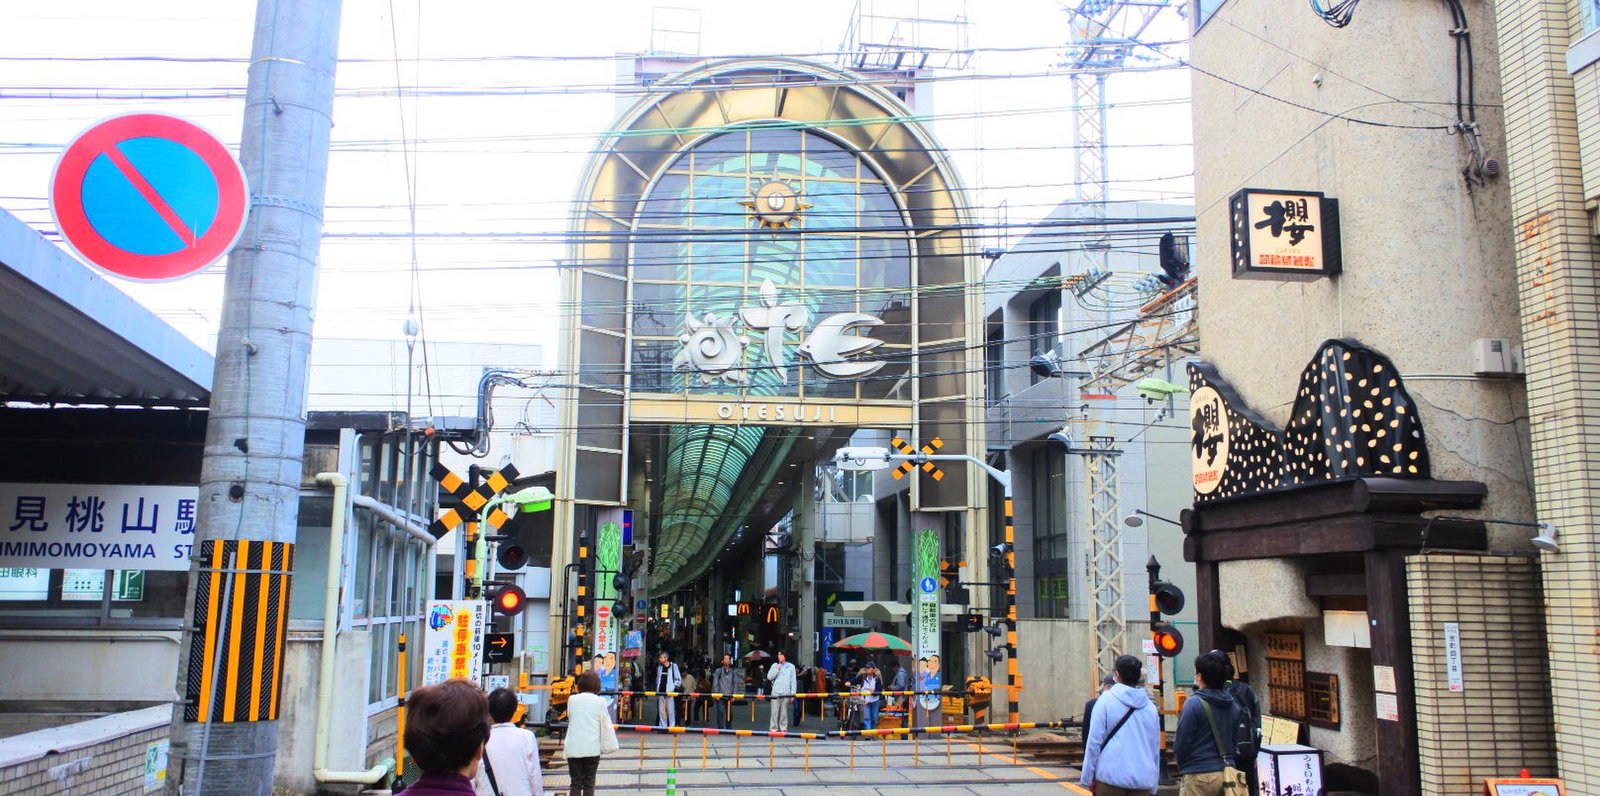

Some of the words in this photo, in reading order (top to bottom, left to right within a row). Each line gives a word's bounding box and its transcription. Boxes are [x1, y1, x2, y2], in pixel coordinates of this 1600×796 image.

[1254, 198, 1315, 246] 櫻
[717, 403, 836, 421] OTESUJI
[1192, 397, 1224, 467] 櫻
